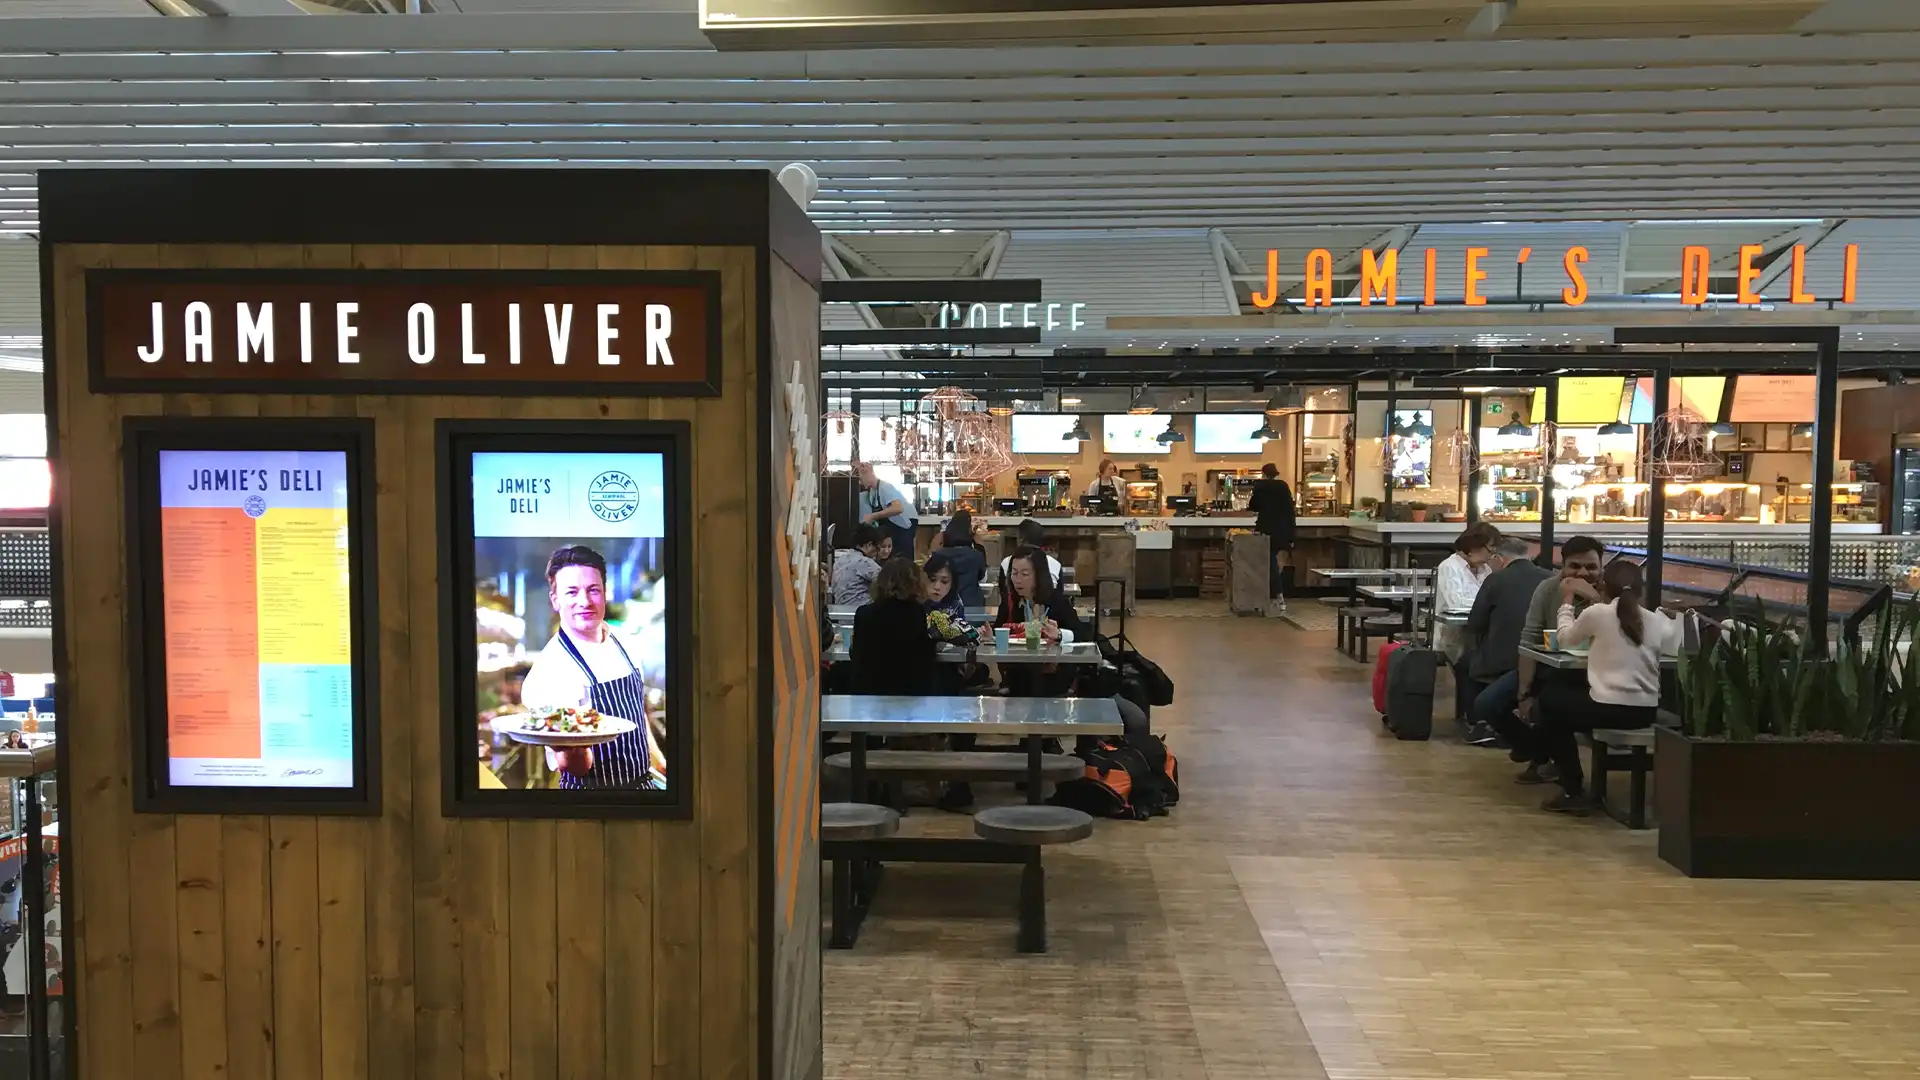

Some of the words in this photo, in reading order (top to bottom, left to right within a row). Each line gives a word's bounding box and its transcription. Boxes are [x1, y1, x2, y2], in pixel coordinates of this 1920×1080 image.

[1252, 246, 1588, 308] JAMIE'S
[1682, 244, 1858, 305] DELI
[137, 301, 360, 364] JAMIE
[407, 302, 675, 366] OLIVER
[187, 469, 269, 492] JAMIE'S
[279, 469, 322, 492] DELI
[497, 478, 551, 494] JAMIE'S
[595, 473, 632, 488] JAMIE
[510, 498, 538, 514] DELI
[594, 503, 635, 520] OLIVER
